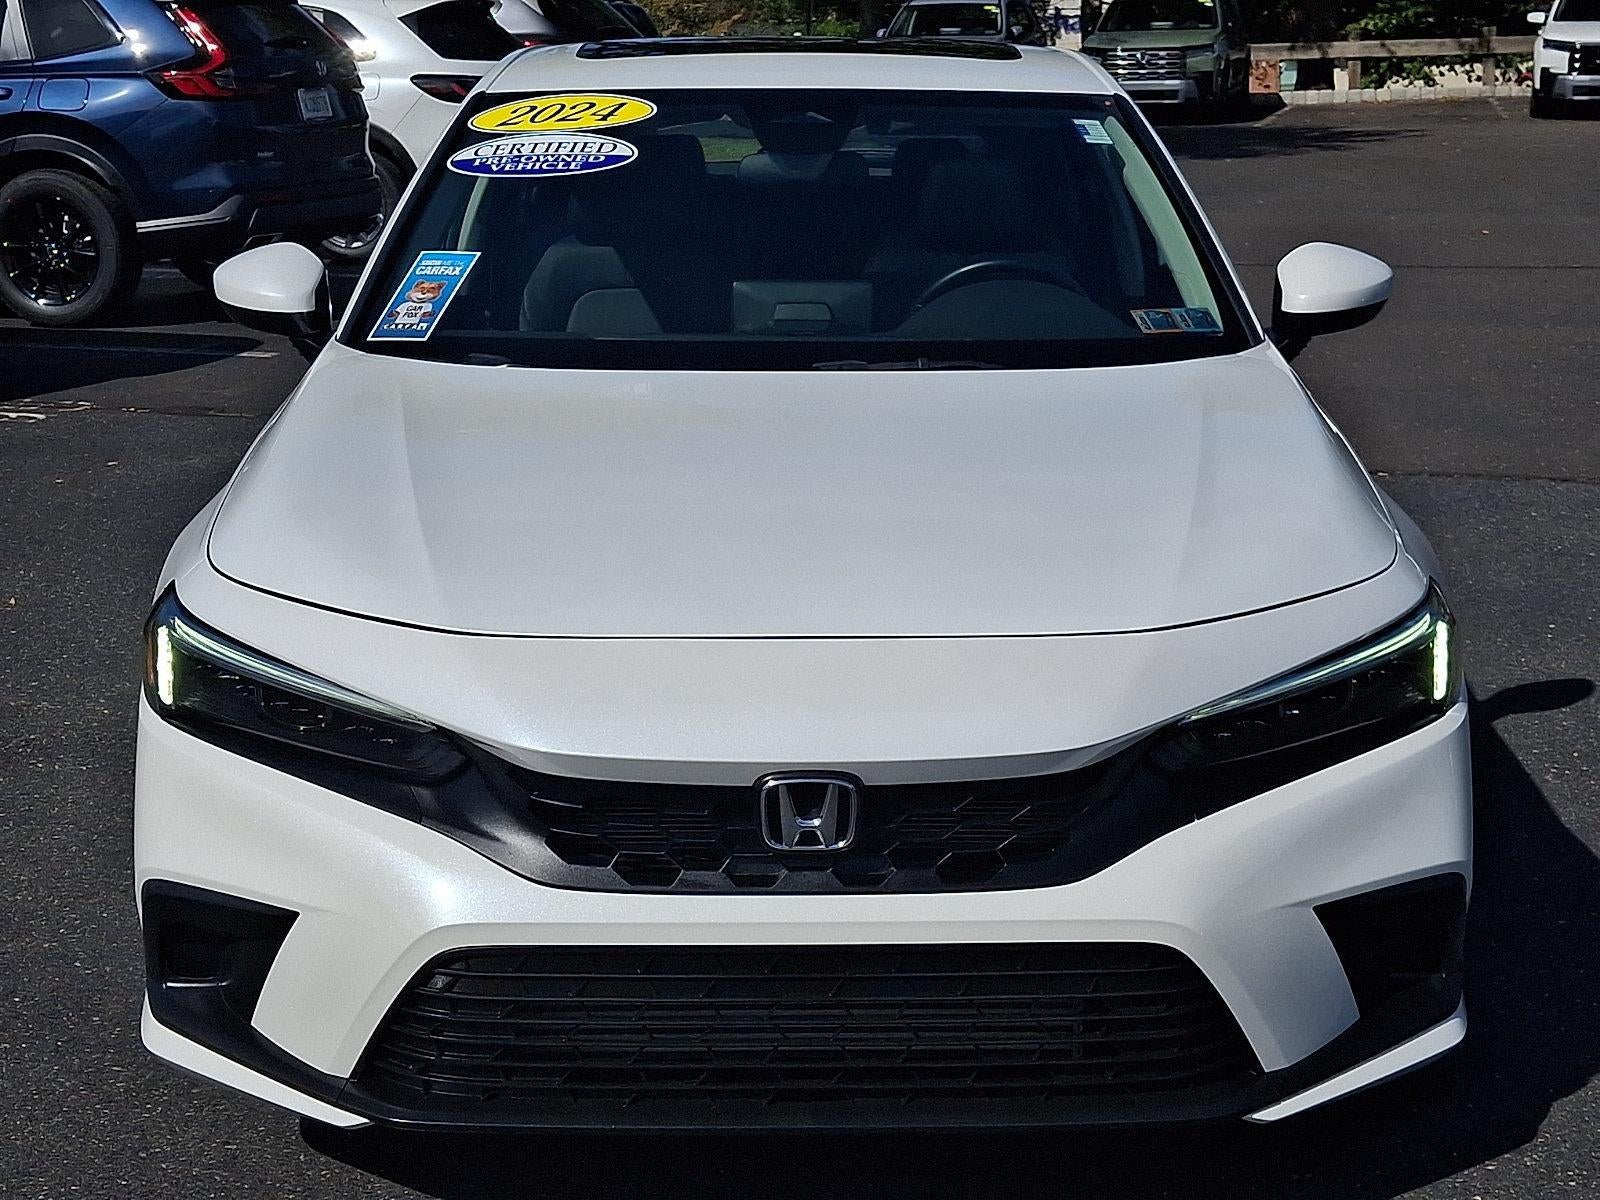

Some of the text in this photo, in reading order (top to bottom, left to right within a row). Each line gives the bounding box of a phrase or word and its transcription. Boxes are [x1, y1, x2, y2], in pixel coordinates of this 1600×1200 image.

[494, 101, 628, 128] 2024
[473, 141, 618, 158] CERTIFIED
[472, 154, 605, 167] PRE-OWNED
[491, 161, 582, 172] VEHICLE
[415, 265, 463, 276] CARFAX
[402, 311, 420, 319] FOX
